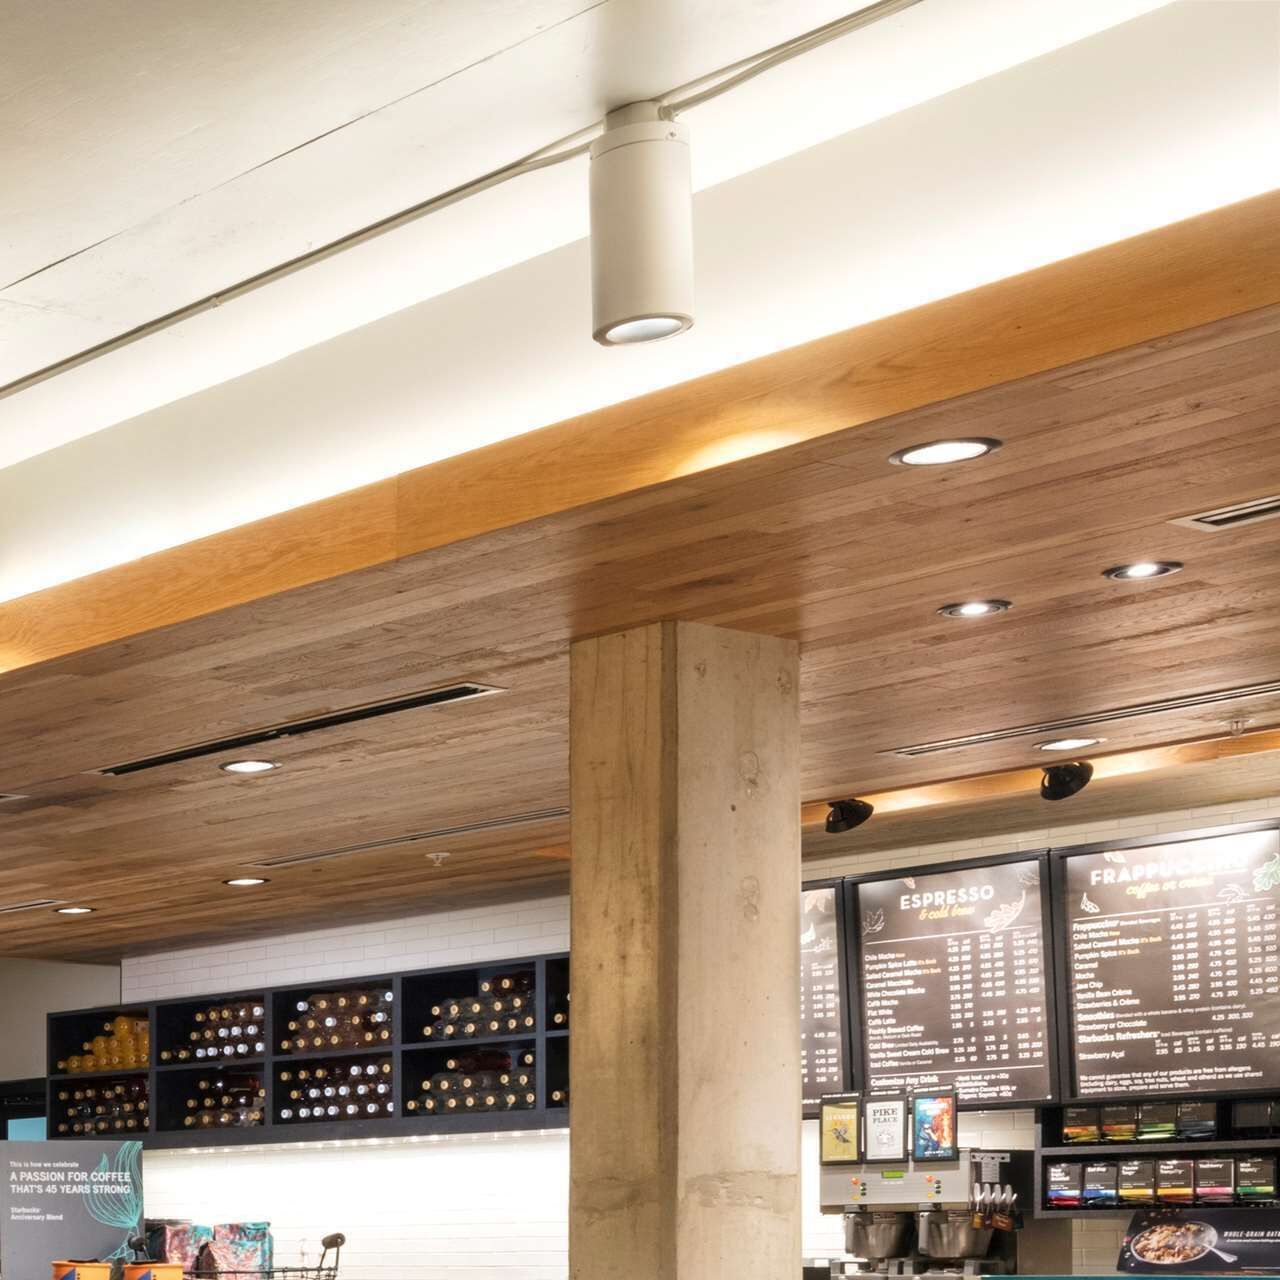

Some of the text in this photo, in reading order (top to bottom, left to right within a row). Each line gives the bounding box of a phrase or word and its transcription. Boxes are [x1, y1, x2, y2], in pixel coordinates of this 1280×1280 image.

[1090, 850, 1248, 887] FRAPPUC
[899, 885, 995, 910] ESPRESSO
[872, 1107, 898, 1117] PIKE
[872, 1115, 898, 1124] PLACE
[9, 1172, 131, 1182] A PASSION FOR COFFEE
[10, 1184, 131, 1194] THAT'S 45 YEARS STRONG
